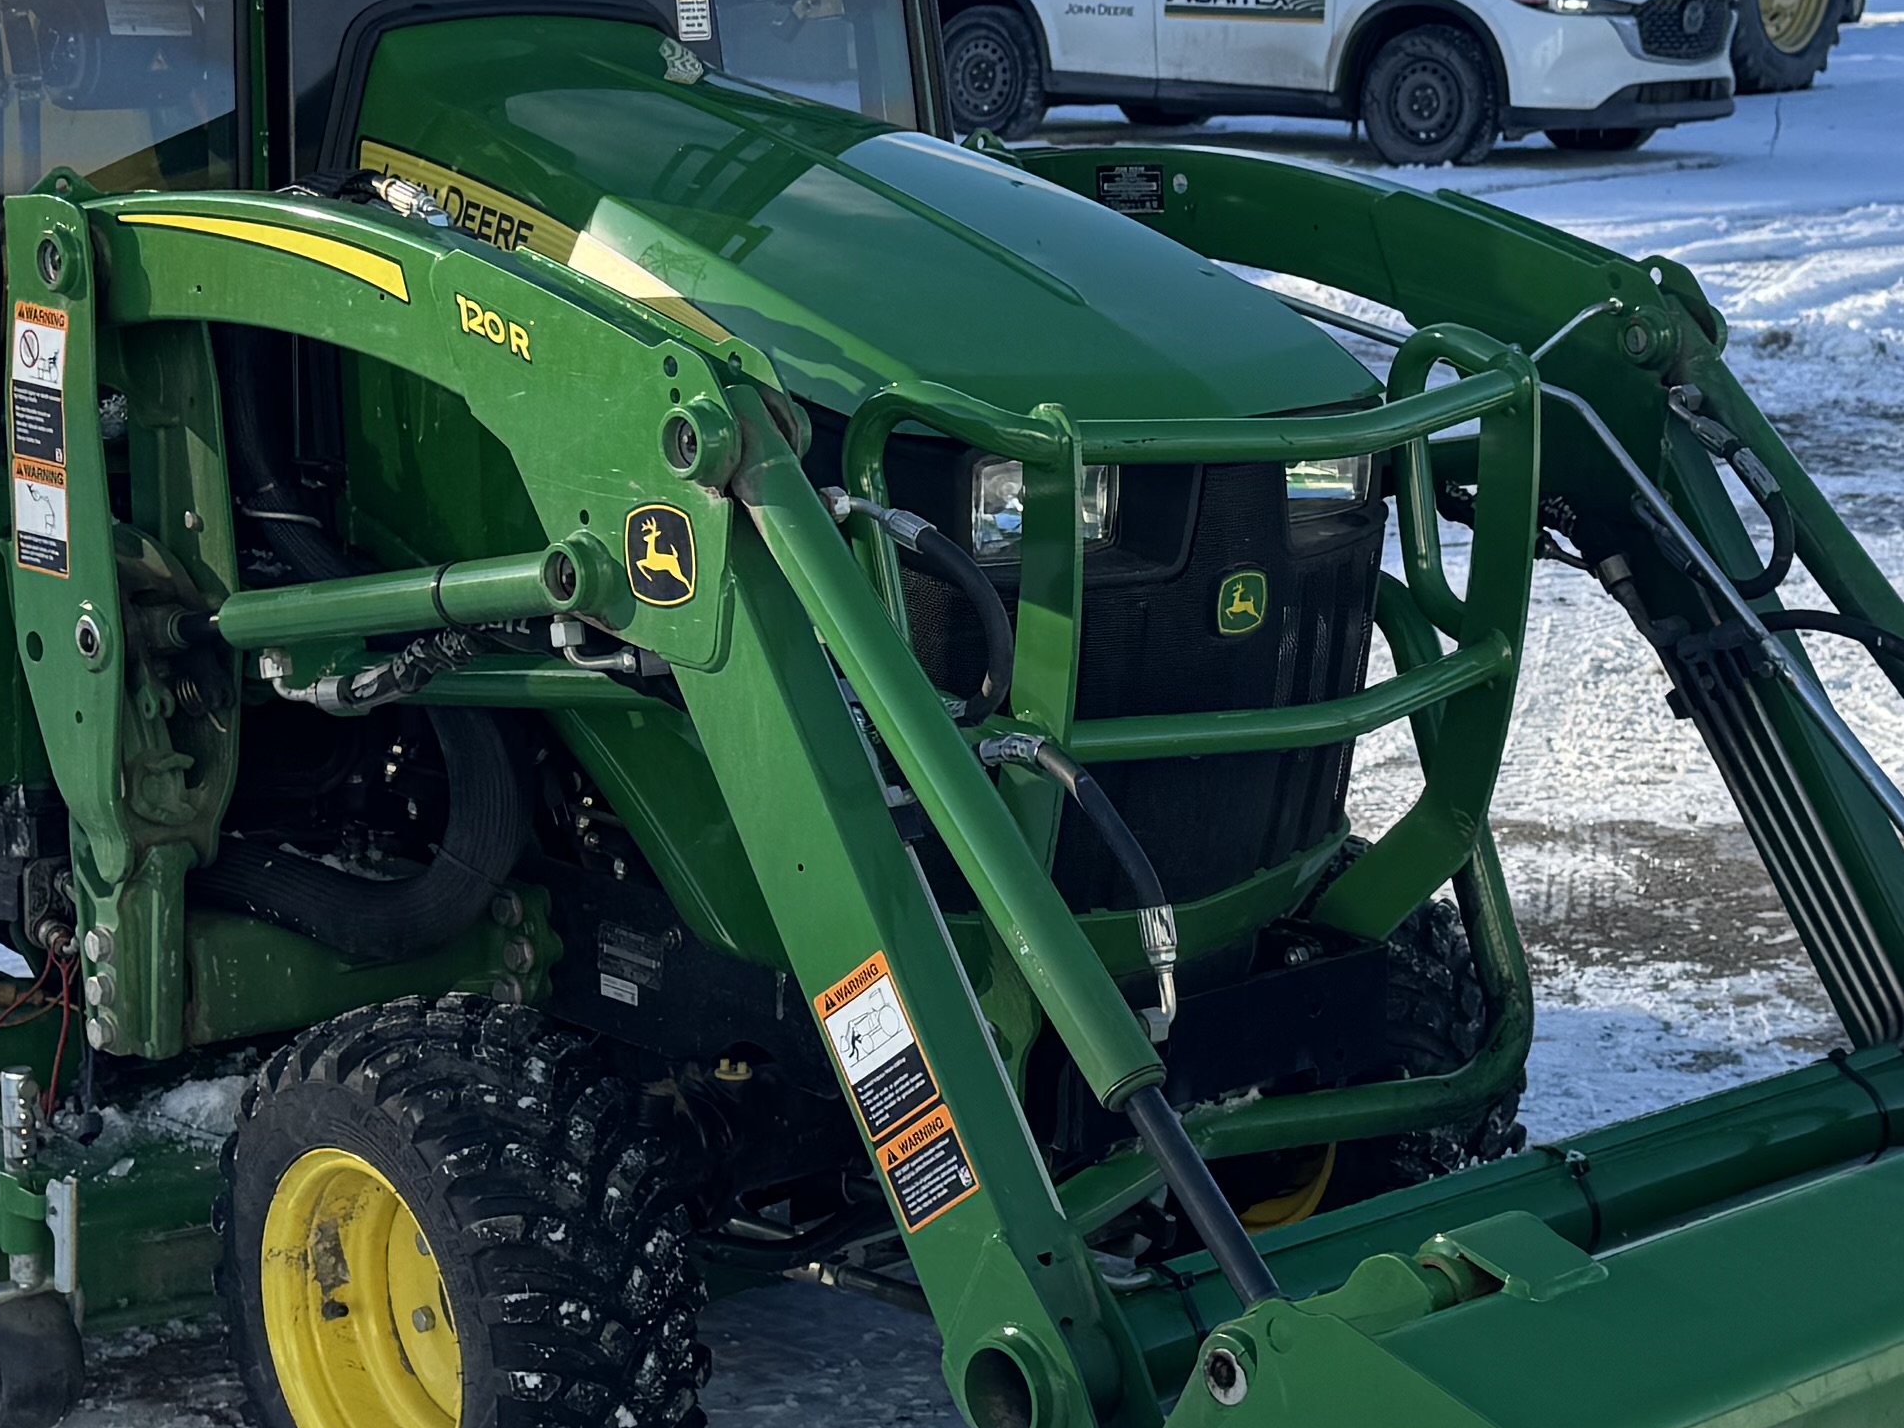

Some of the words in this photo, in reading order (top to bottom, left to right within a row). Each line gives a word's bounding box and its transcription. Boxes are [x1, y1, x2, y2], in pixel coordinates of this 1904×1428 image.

[24, 305, 65, 328] WARNING
[23, 464, 64, 486] WARNING
[834, 963, 879, 1003] WARNING
[898, 1116, 945, 1155] WARNING
